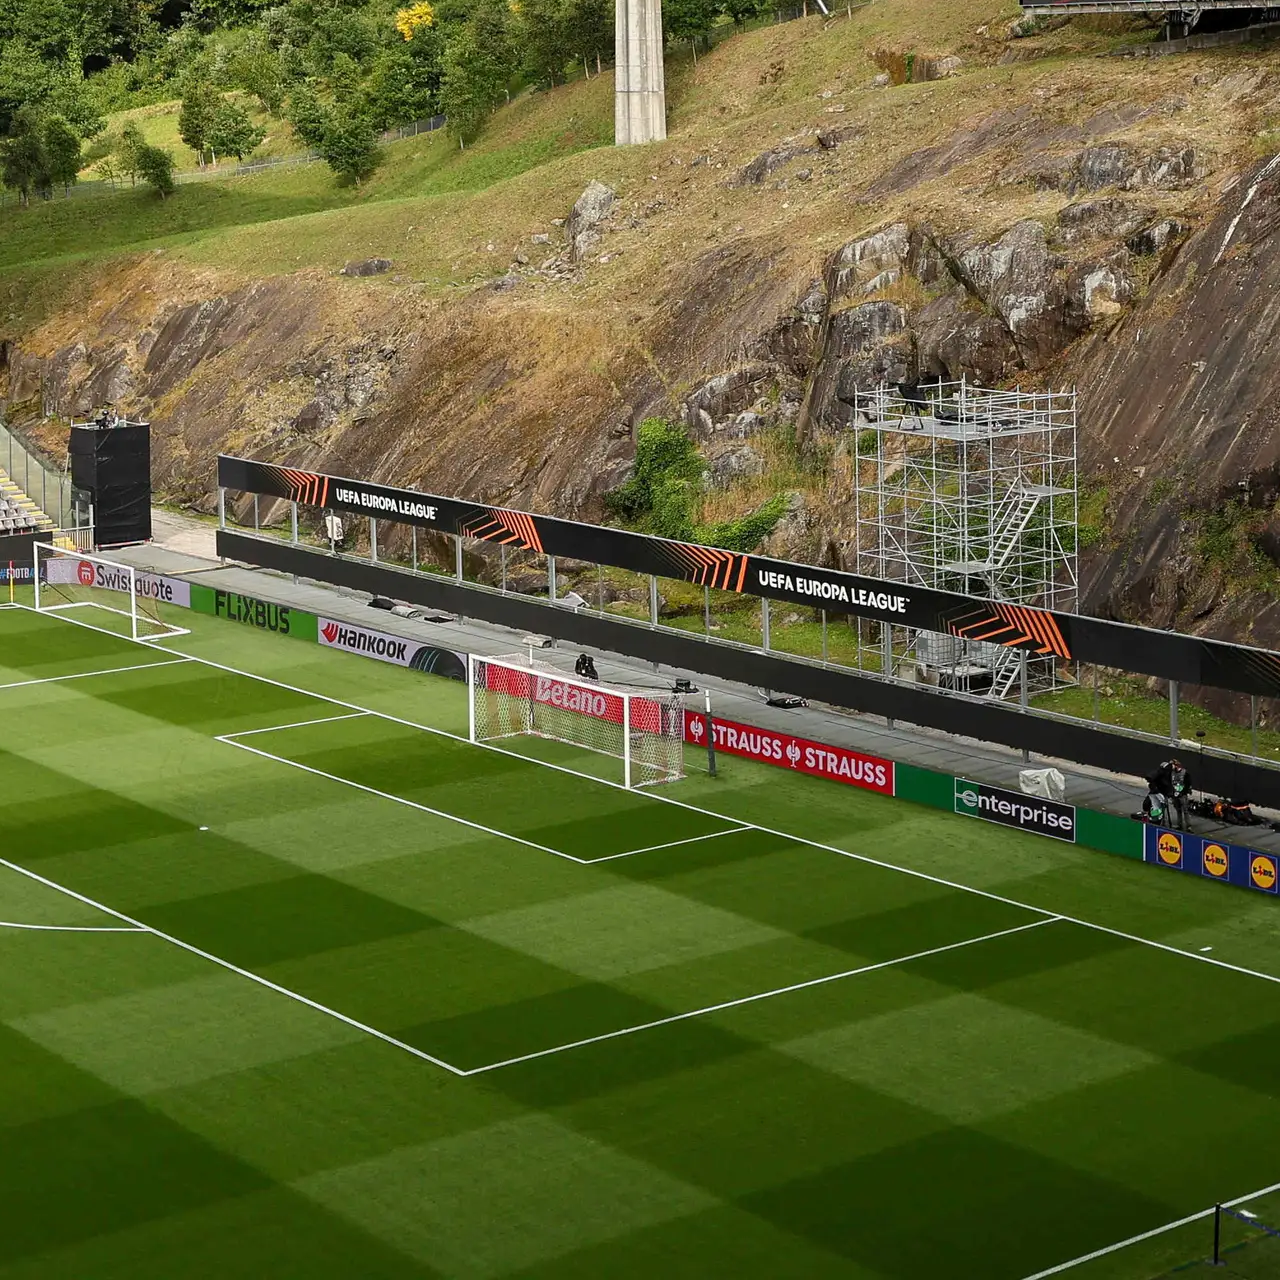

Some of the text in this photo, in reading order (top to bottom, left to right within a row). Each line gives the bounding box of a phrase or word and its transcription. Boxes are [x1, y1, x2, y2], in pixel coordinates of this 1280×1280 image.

[335, 487, 437, 520] UEFA EUROPA LEAGUE
[758, 570, 907, 613] UEFA EUROPA LEAGUE
[535, 675, 607, 716] Betano
[710, 723, 887, 787] STRAUSS STRAUSS
[960, 789, 1073, 830] enterprise
